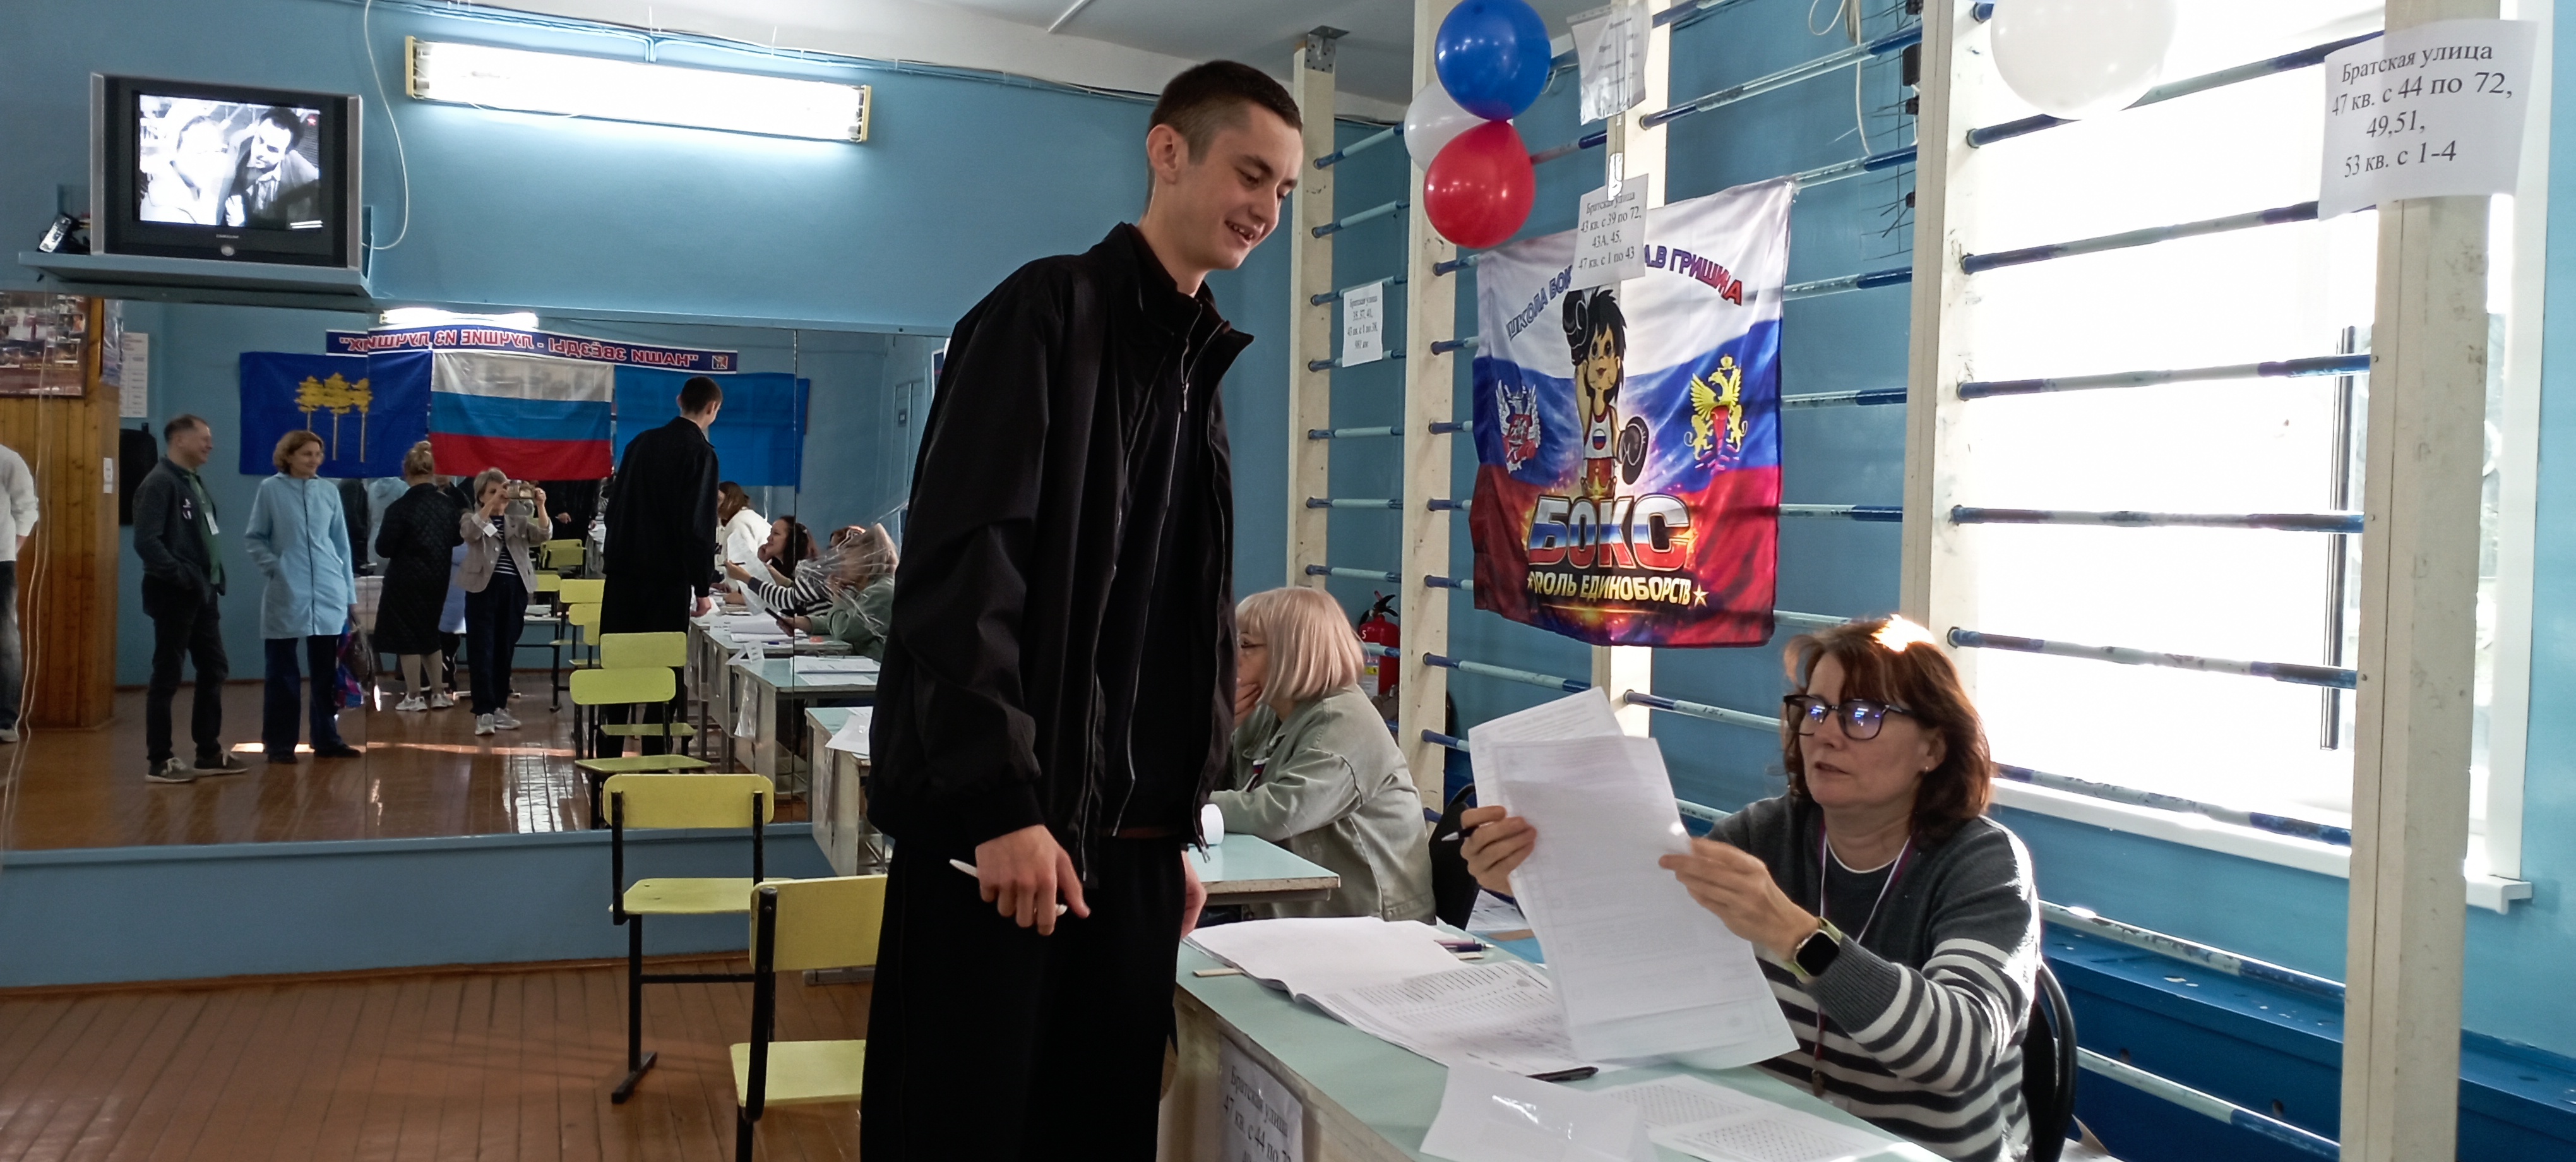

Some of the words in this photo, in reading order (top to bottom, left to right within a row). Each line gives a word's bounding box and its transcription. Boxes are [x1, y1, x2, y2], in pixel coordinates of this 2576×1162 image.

[2342, 52, 2416, 85] Братская
[2421, 45, 2493, 69] улица
[2332, 93, 2348, 116] 47
[2351, 91, 2375, 112] кв.
[2382, 87, 2392, 103] с
[2397, 75, 2423, 99] 44
[2429, 76, 2462, 95] по
[2474, 71, 2513, 99] 72,
[2344, 154, 2360, 178] 53
[2364, 154, 2389, 173] кв.
[2397, 149, 2408, 165] с
[2418, 140, 2457, 164] 1-4
[1580, 220, 1589, 233] 43
[1601, 218, 1606, 228] с
[1607, 212, 1616, 226] 39
[1618, 212, 1628, 223] по
[1630, 206, 1642, 219] 72,
[1578, 258, 1588, 270] 47
[1601, 256, 1606, 265] с
[1614, 253, 1623, 263] по
[1625, 246, 1634, 259] 43
[1506, 287, 1548, 342] ШКОЛА
[1549, 264, 1573, 300] БОК
[1669, 248, 1742, 306] ГРИШИНА
[1527, 493, 1691, 572] БОКС
[1580, 574, 1691, 605] ЕДИНОБОРСТВ
[1224, 1094, 1234, 1115] 47
[1248, 1124, 1253, 1140] с
[1255, 1127, 1265, 1152] 44
[1267, 1143, 1279, 1162] по
